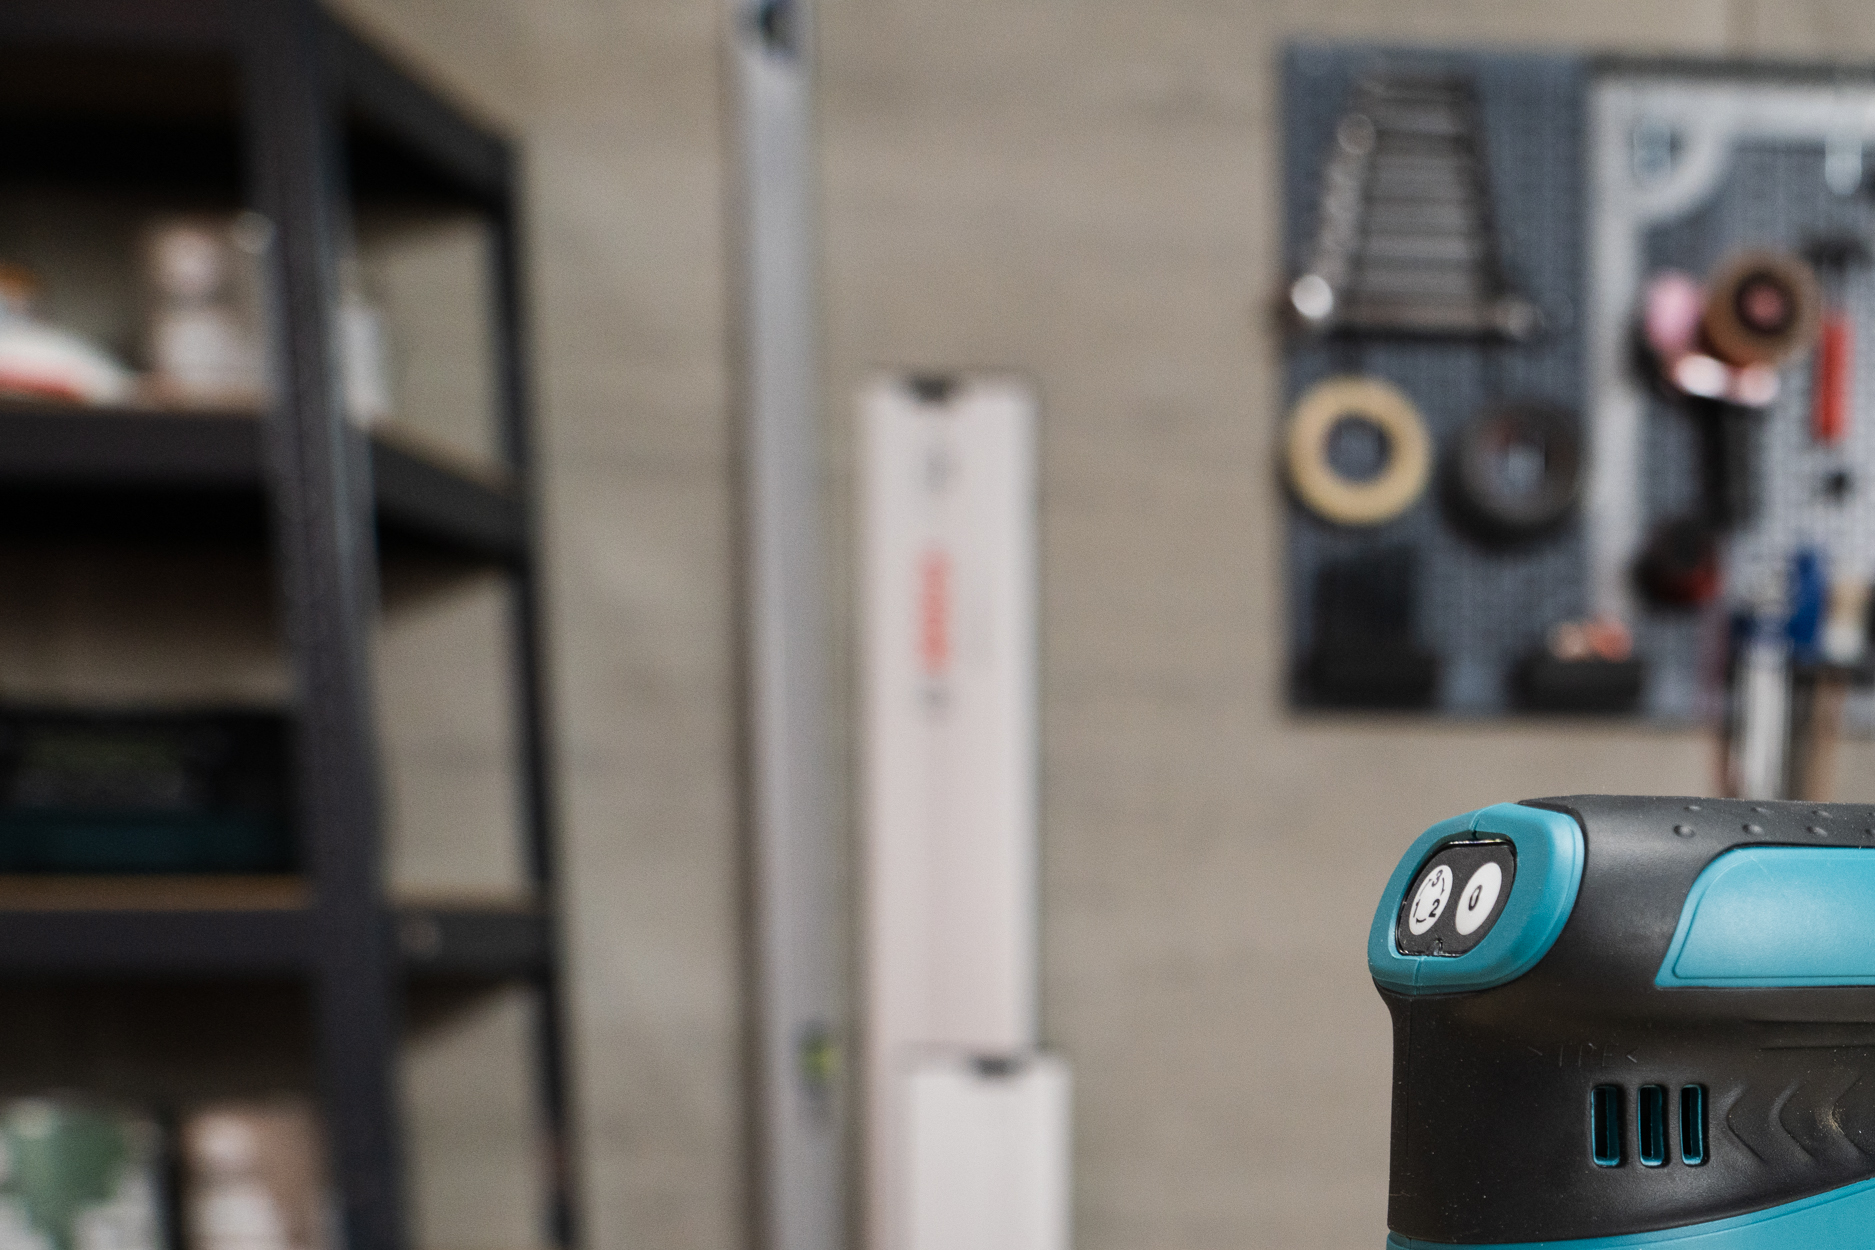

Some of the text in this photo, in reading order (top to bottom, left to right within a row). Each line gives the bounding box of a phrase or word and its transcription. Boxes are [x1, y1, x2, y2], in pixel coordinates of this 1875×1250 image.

[1431, 869, 1443, 887] 3
[1413, 899, 1421, 918] 1
[1429, 899, 1440, 918] 2
